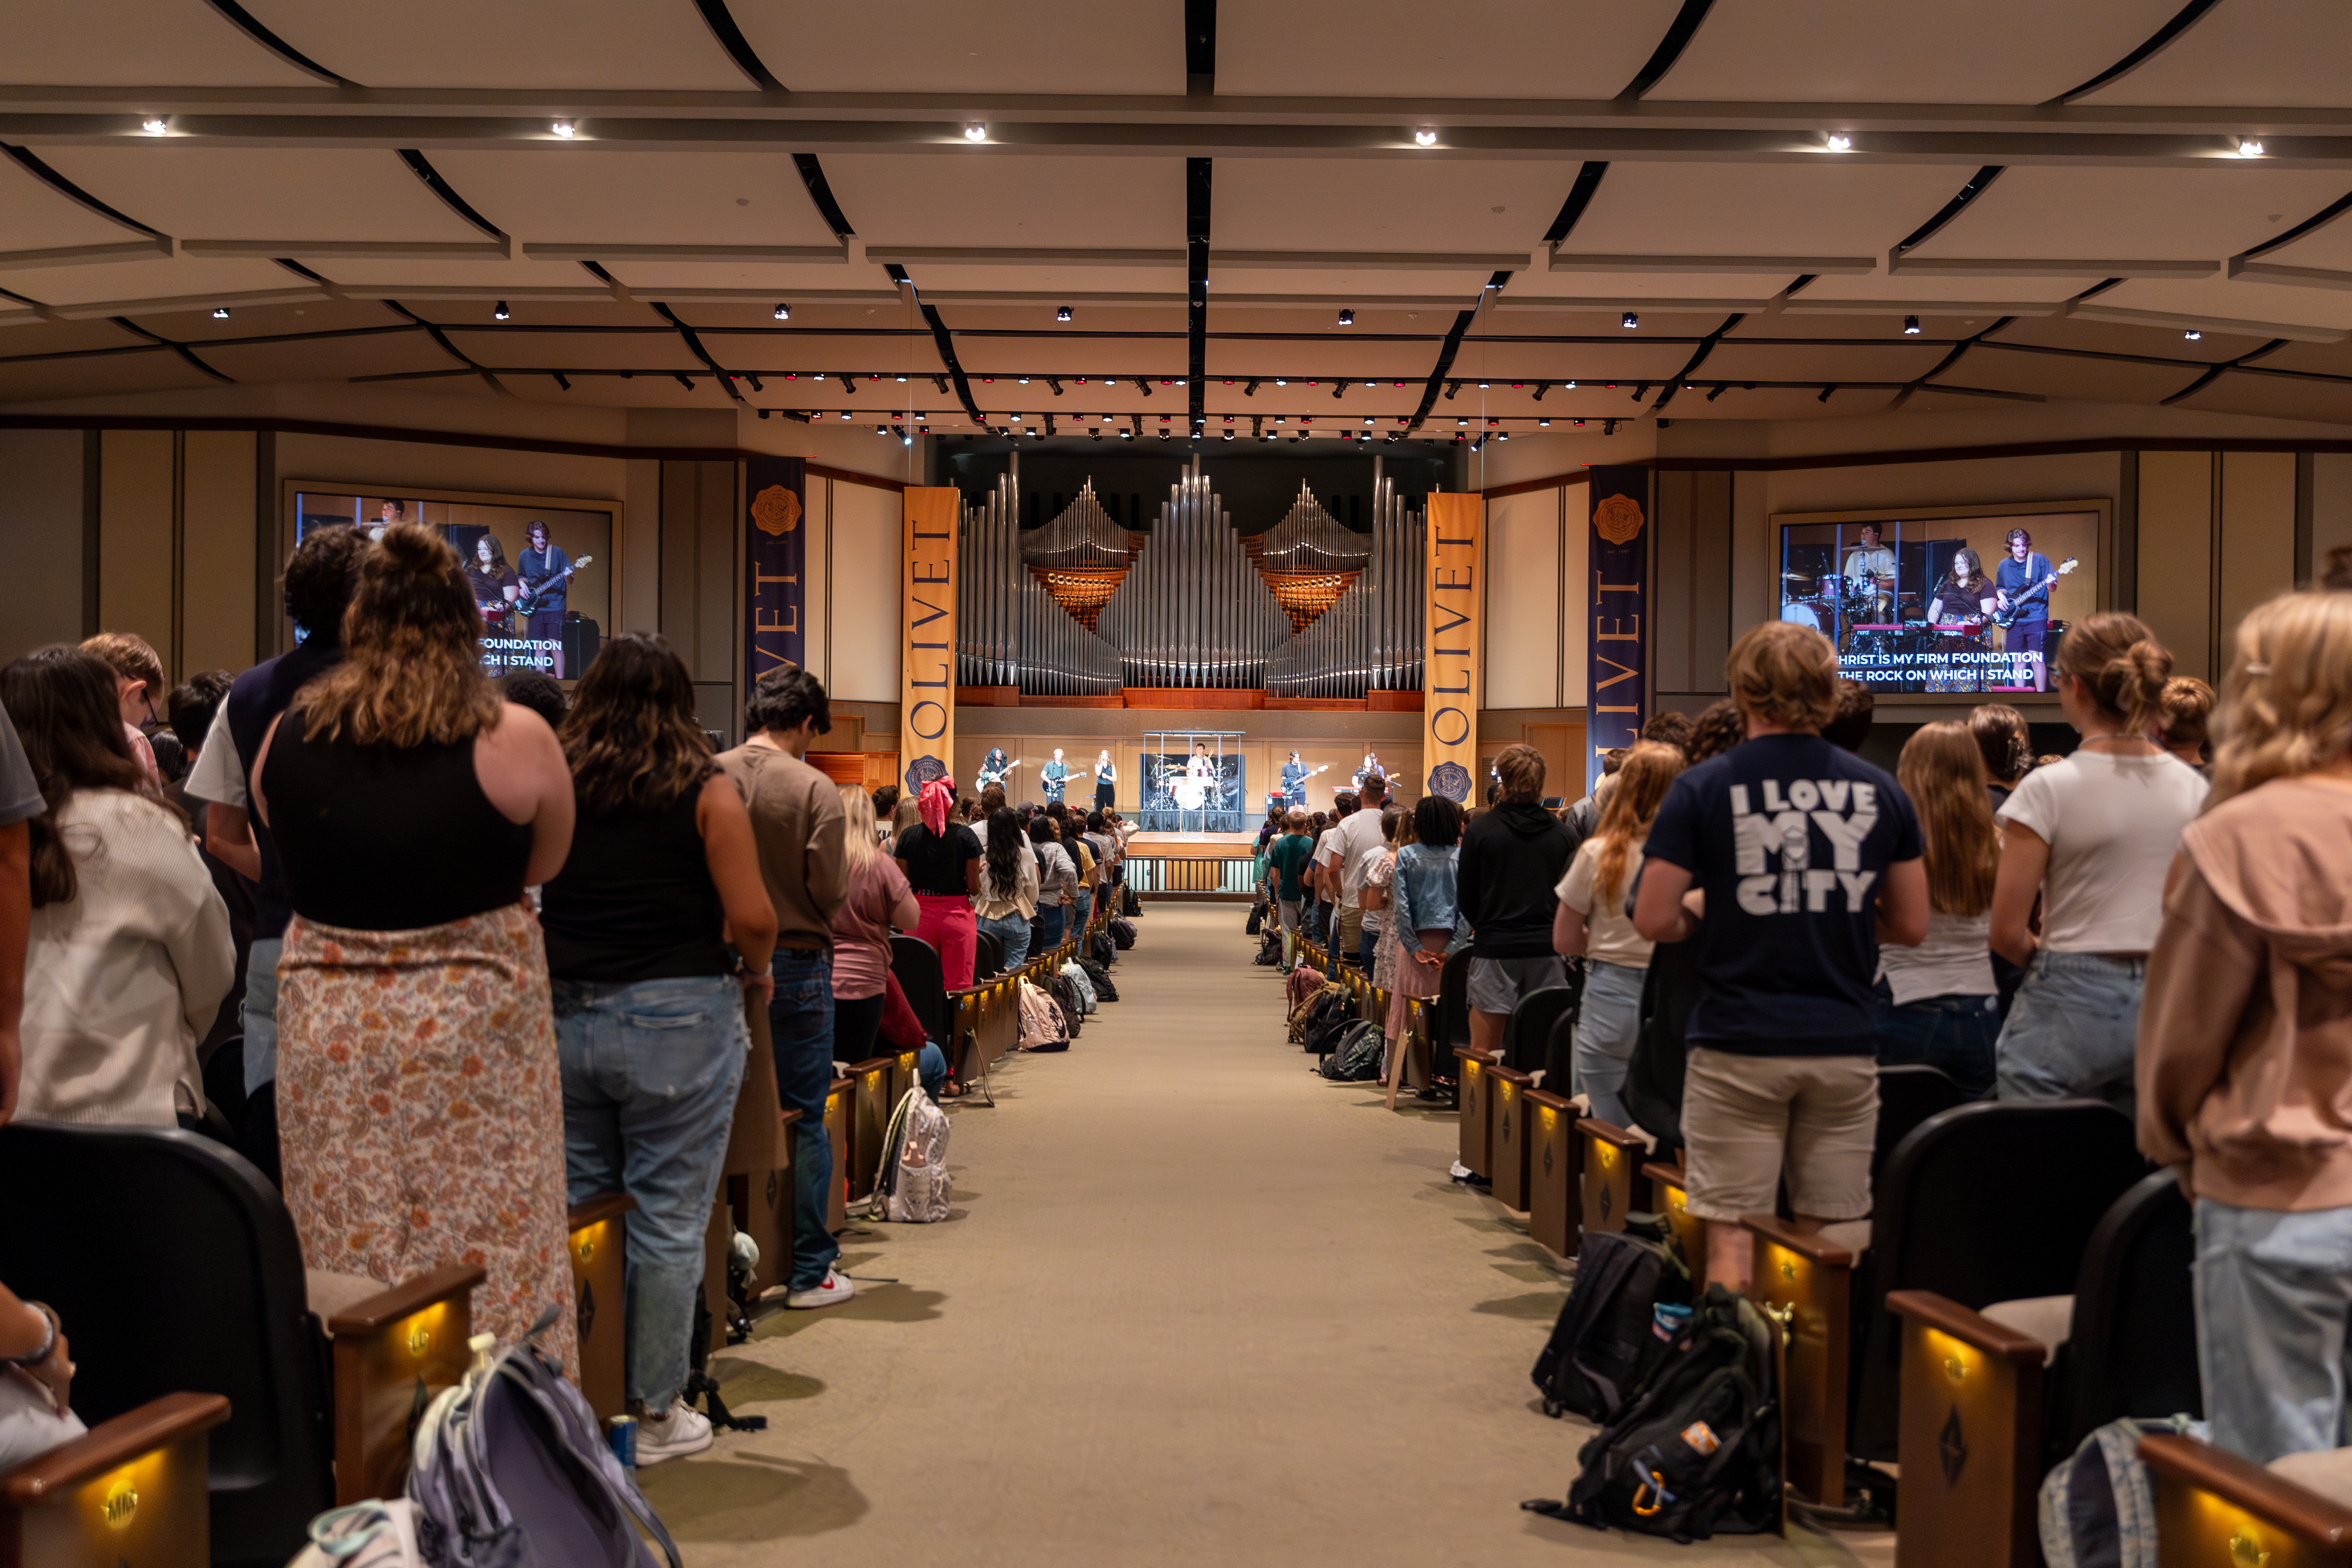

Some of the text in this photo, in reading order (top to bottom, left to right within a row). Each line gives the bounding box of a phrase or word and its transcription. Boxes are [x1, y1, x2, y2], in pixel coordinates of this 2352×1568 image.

[754, 561, 797, 684] VET
[910, 520, 950, 739] OLIVET
[1432, 526, 1473, 746] OLIVET
[504, 655, 508, 665] I
[511, 656, 554, 667] STAND
[1595, 570, 1639, 790] LIVET
[1835, 652, 2043, 665] HRIST IS MY FIRM FOUNDATION
[1838, 669, 2034, 681] THE ROCK ON WHICH I STAND
[1729, 778, 1878, 815] I LOVE
[1733, 810, 1878, 876] MY
[1736, 869, 1877, 916] CITY
